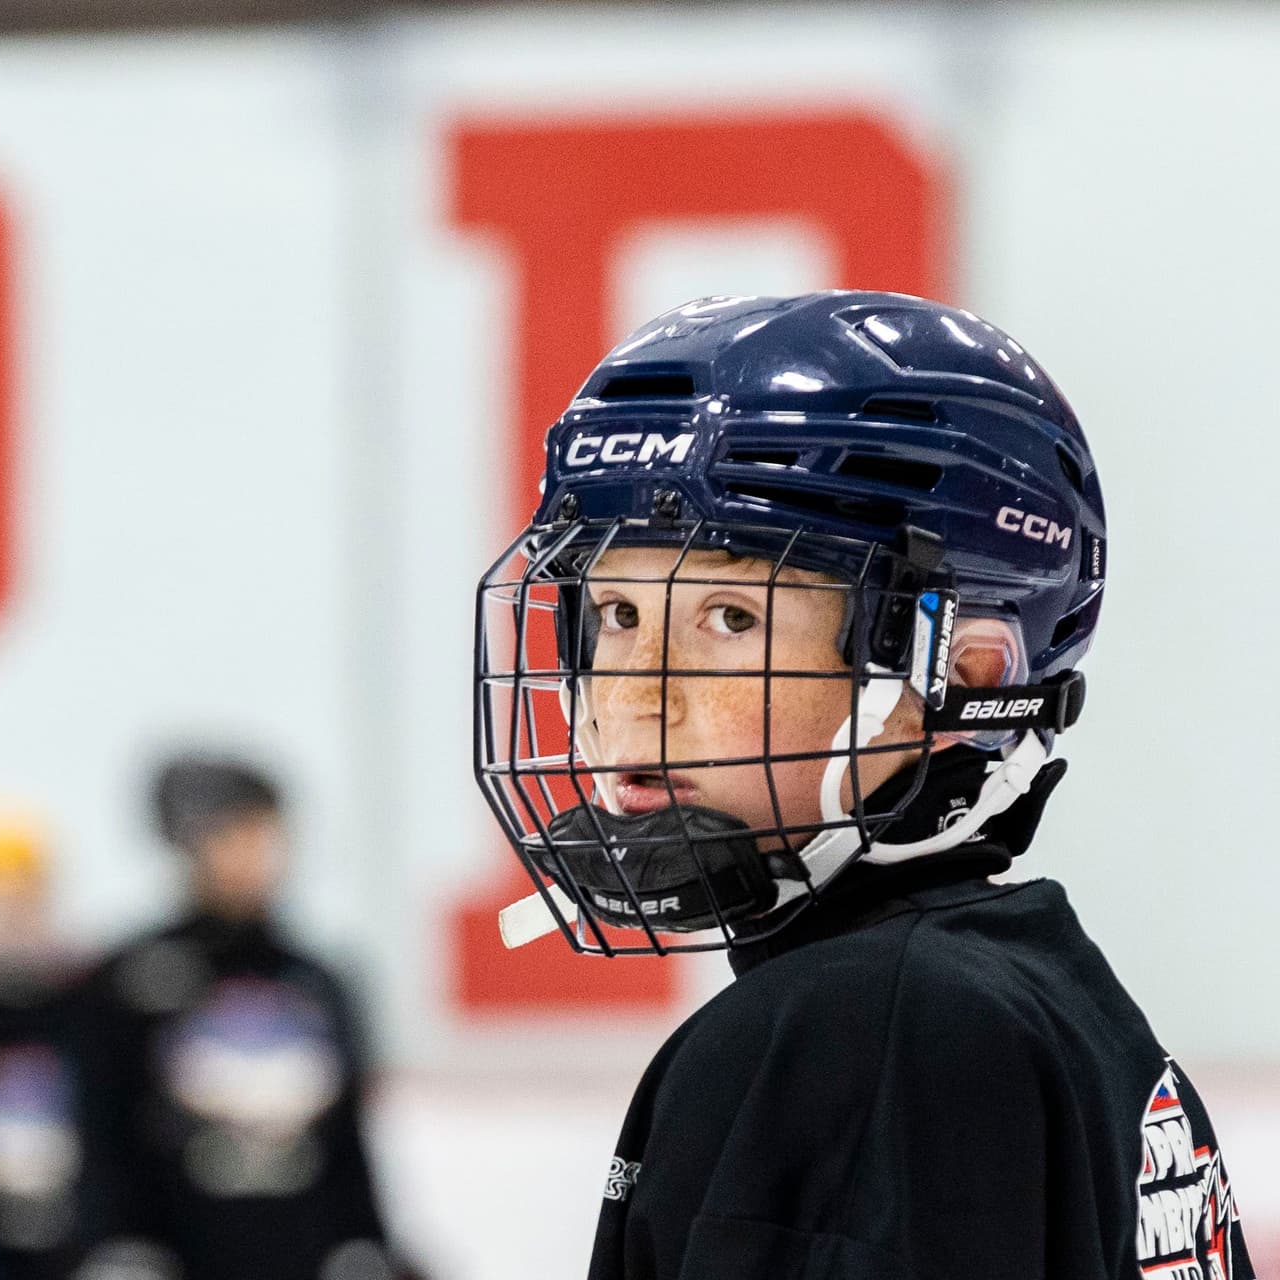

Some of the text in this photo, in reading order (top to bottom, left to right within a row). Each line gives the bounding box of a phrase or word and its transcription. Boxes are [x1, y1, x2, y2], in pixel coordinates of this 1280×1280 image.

[565, 432, 695, 467] CCM
[995, 505, 1072, 550] CCM
[935, 599, 956, 677] BAUER
[960, 697, 1043, 721] BAUER
